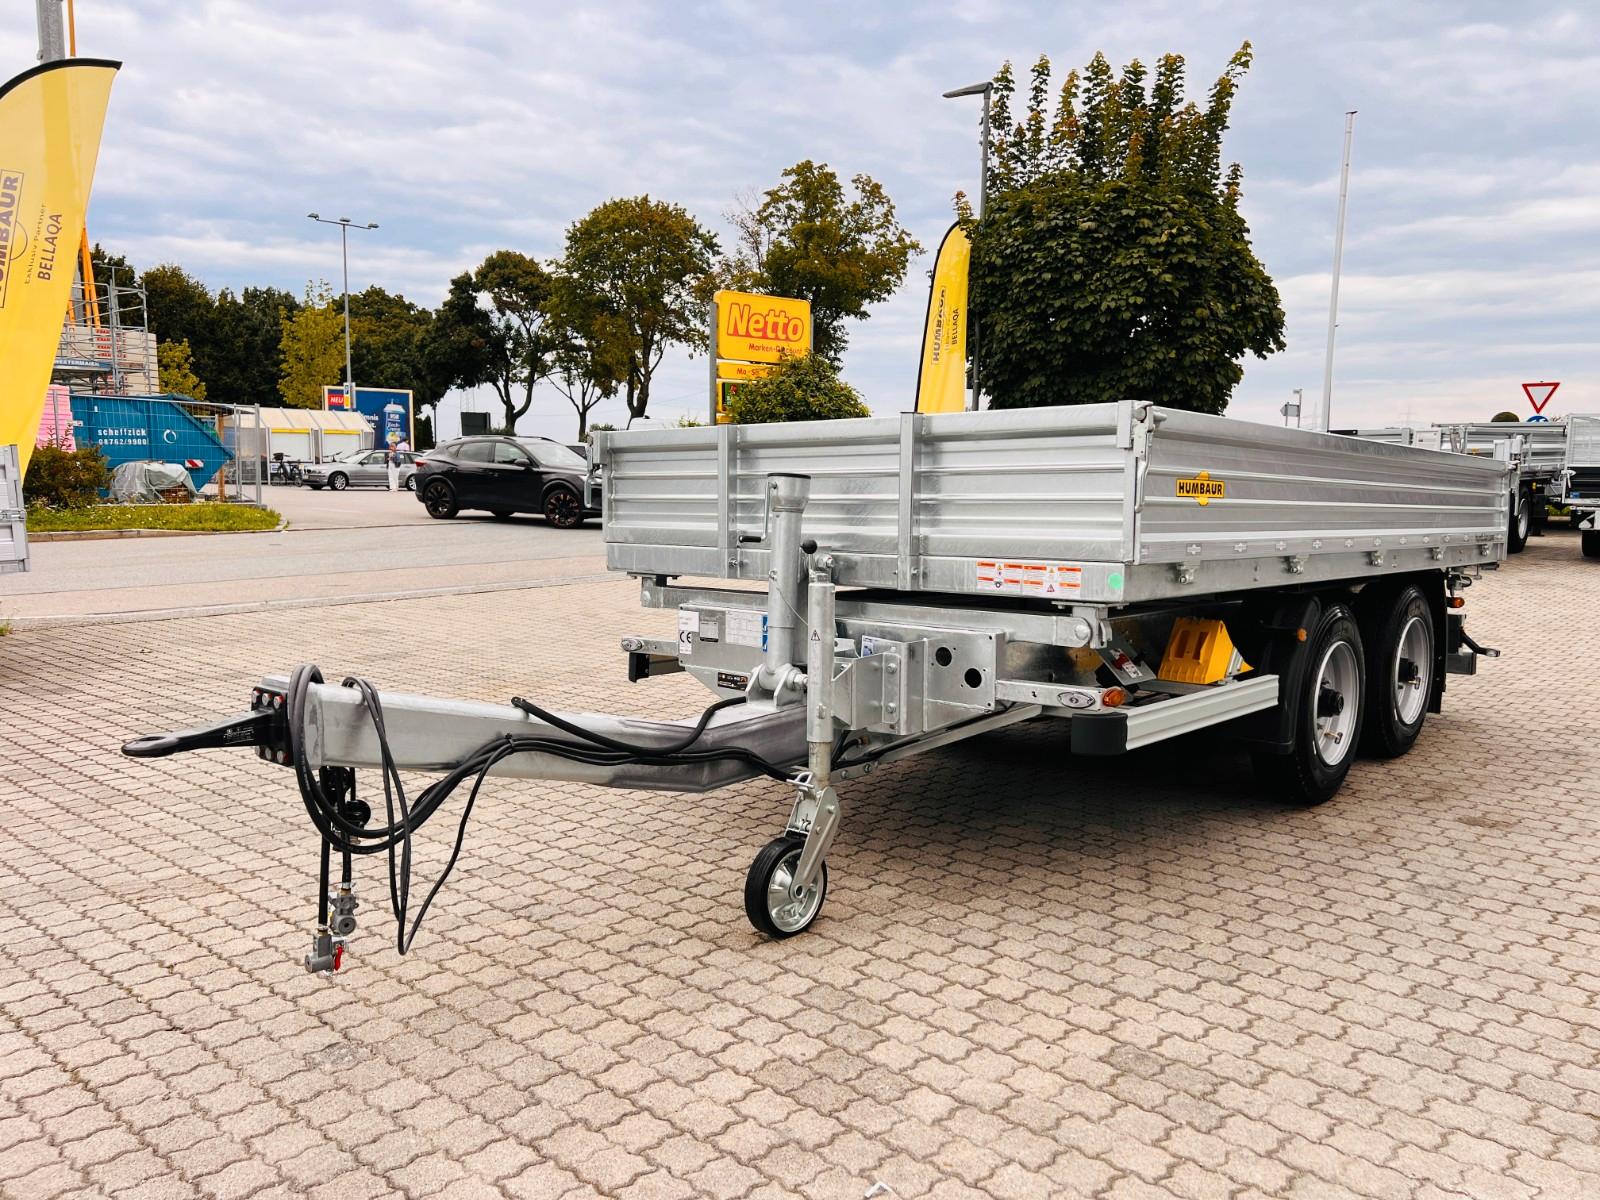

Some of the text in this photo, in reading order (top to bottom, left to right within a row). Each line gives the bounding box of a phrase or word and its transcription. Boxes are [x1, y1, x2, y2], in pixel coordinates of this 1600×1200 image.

[33, 204, 47, 241] Partner
[37, 214, 62, 280] BELLAQA
[727, 302, 804, 342] Netto
[951, 308, 960, 345] BELLAQA
[330, 396, 344, 404] NEU
[1178, 482, 1223, 495] HUMBAUR
